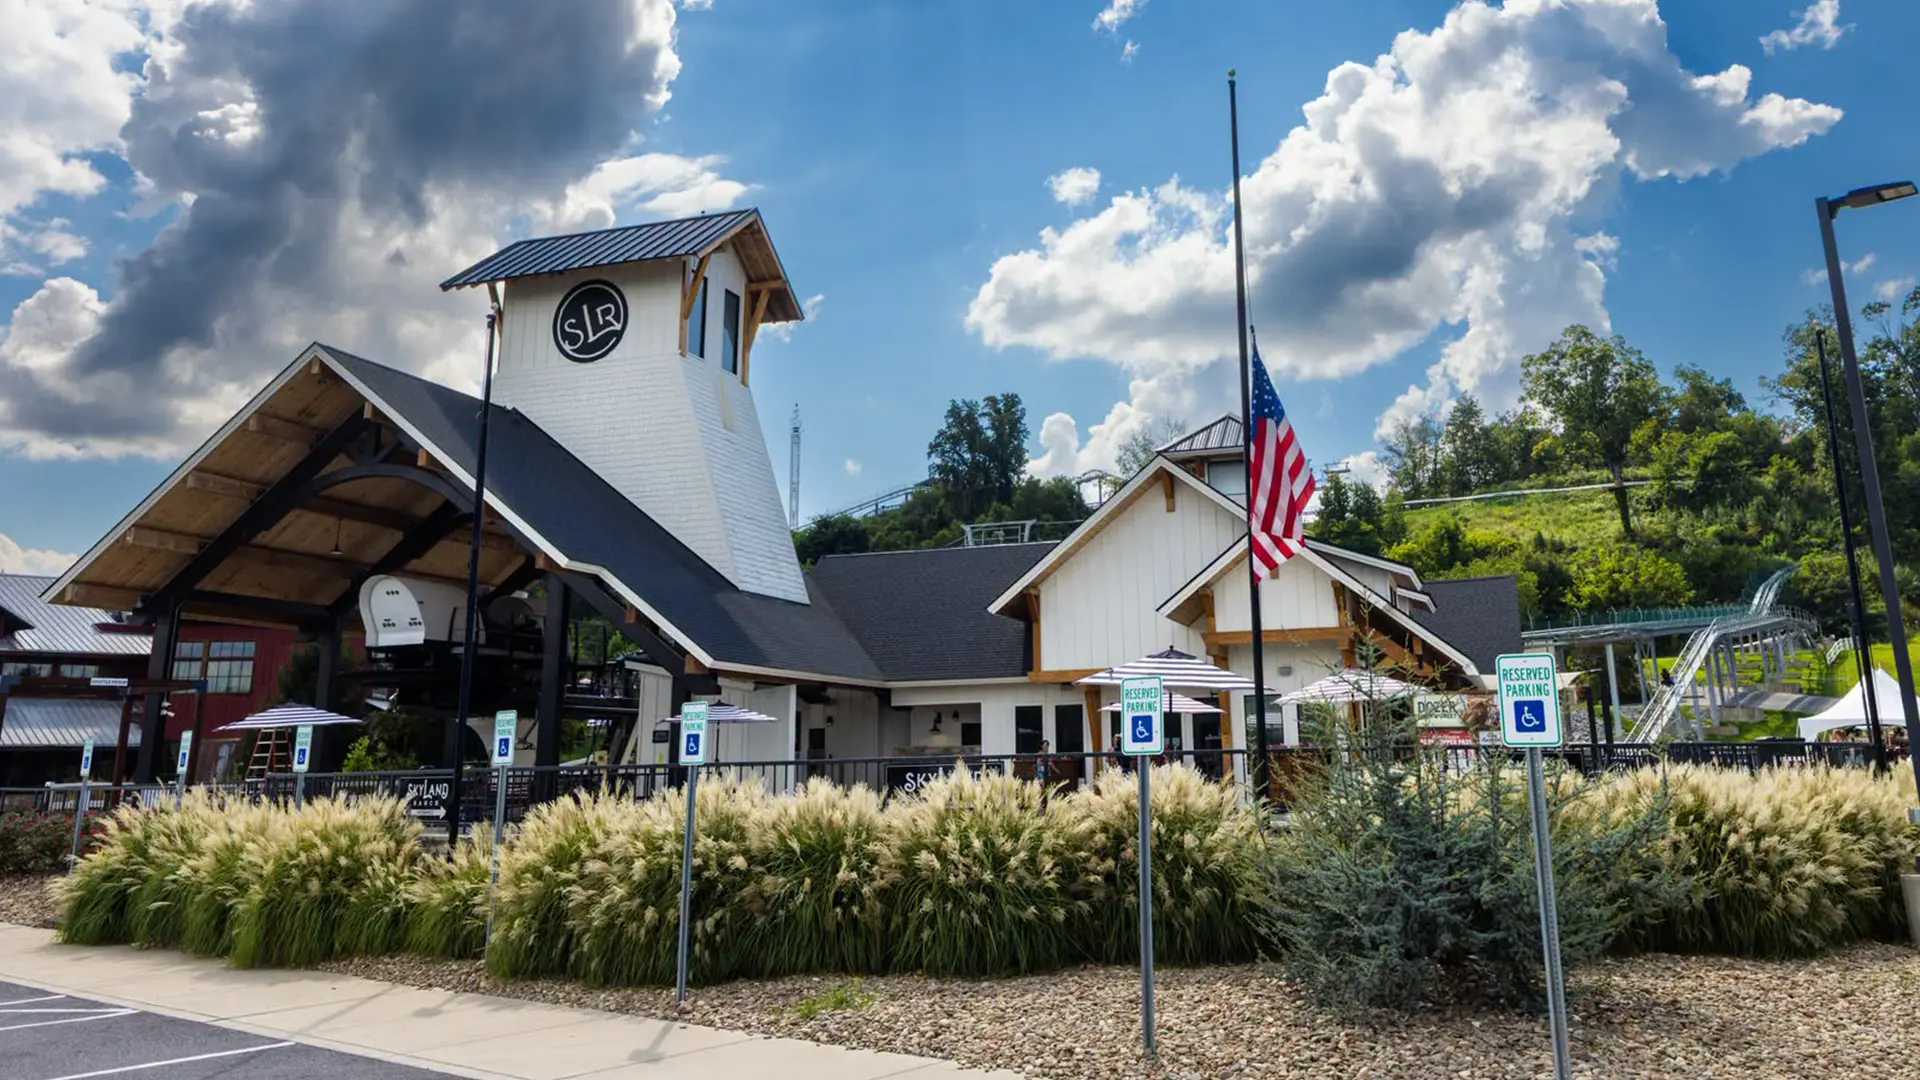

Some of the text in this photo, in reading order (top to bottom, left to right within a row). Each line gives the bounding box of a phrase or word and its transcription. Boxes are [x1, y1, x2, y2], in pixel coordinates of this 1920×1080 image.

[1502, 667, 1550, 681] RESERVED
[1125, 687, 1159, 699] RESERVED
[1506, 683, 1550, 697] PARKING
[1126, 701, 1157, 712] PARKING
[408, 779, 449, 799] SKYLAND
